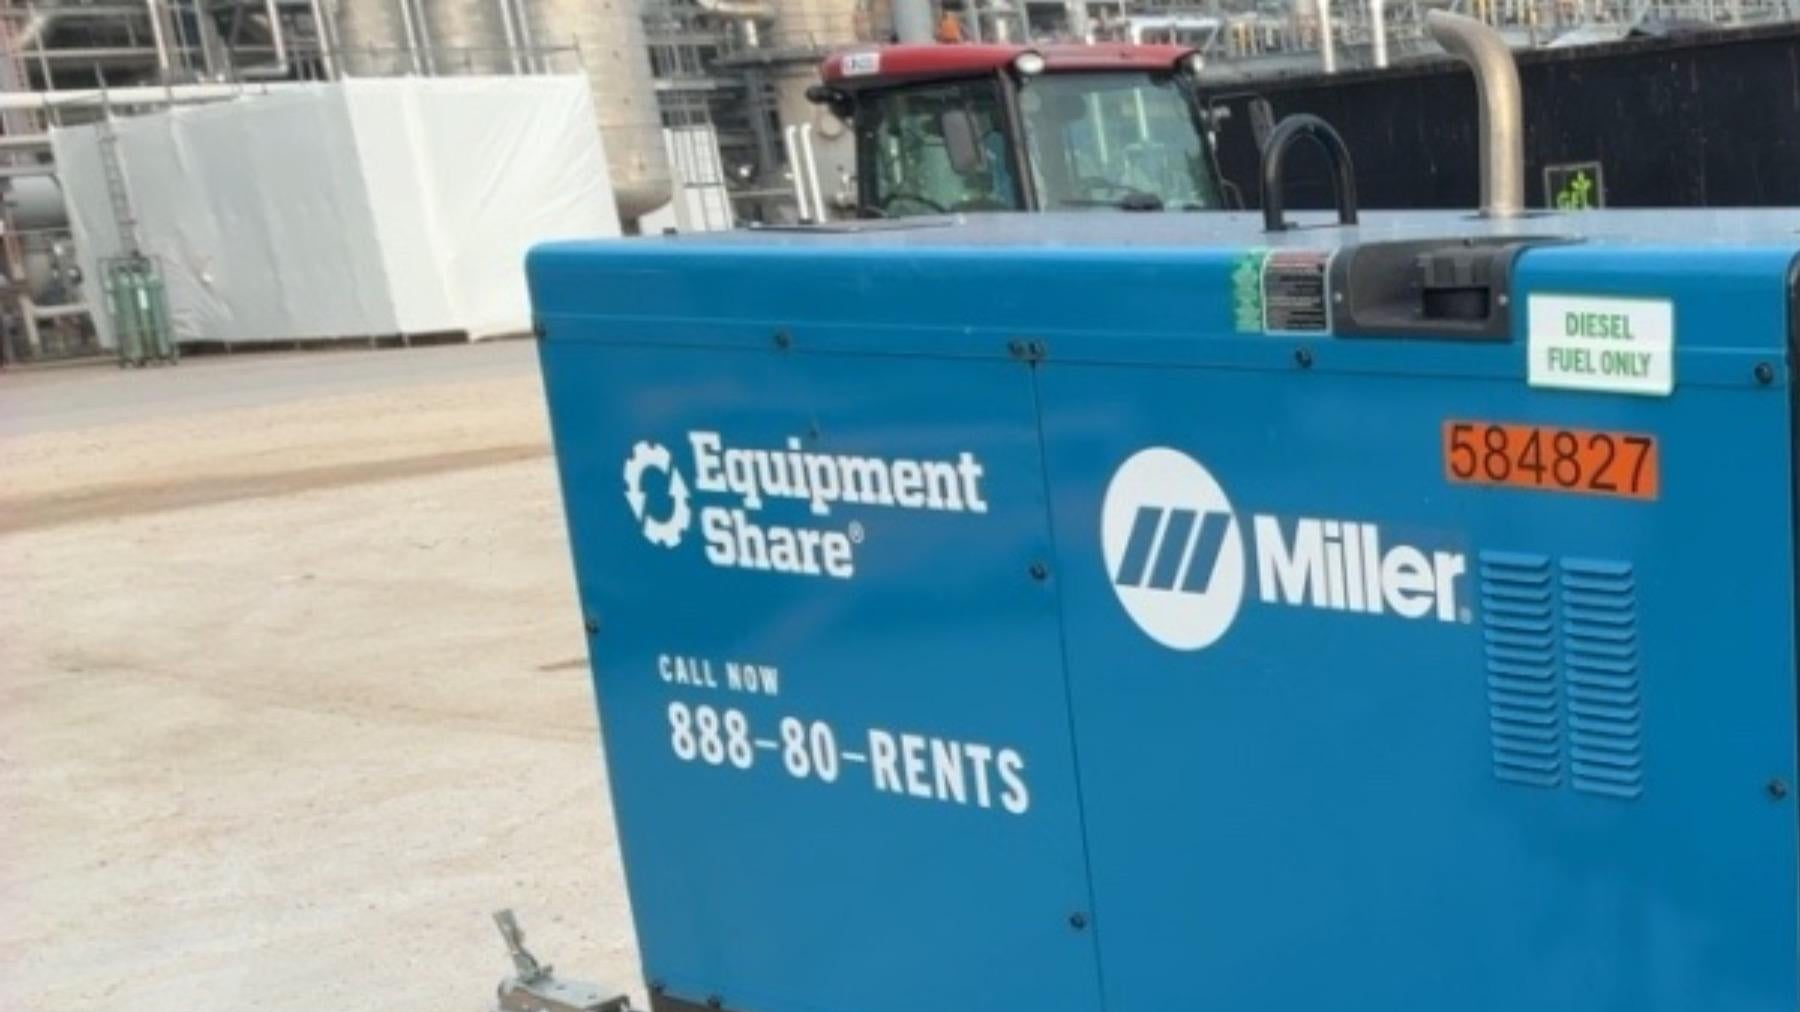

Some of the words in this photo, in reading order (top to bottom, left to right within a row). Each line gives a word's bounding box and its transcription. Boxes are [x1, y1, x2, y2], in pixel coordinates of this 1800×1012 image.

[1565, 311, 1635, 340] DIESEL
[1547, 346, 1597, 374] FUEL
[1601, 350, 1652, 378] ONLY
[688, 431, 988, 514] Equipment
[1447, 421, 1654, 493] 584827
[1253, 514, 1465, 622] Miller
[658, 654, 718, 689] CALL
[727, 662, 780, 696] NOW
[667, 701, 1030, 816] 888-80-RENTS
